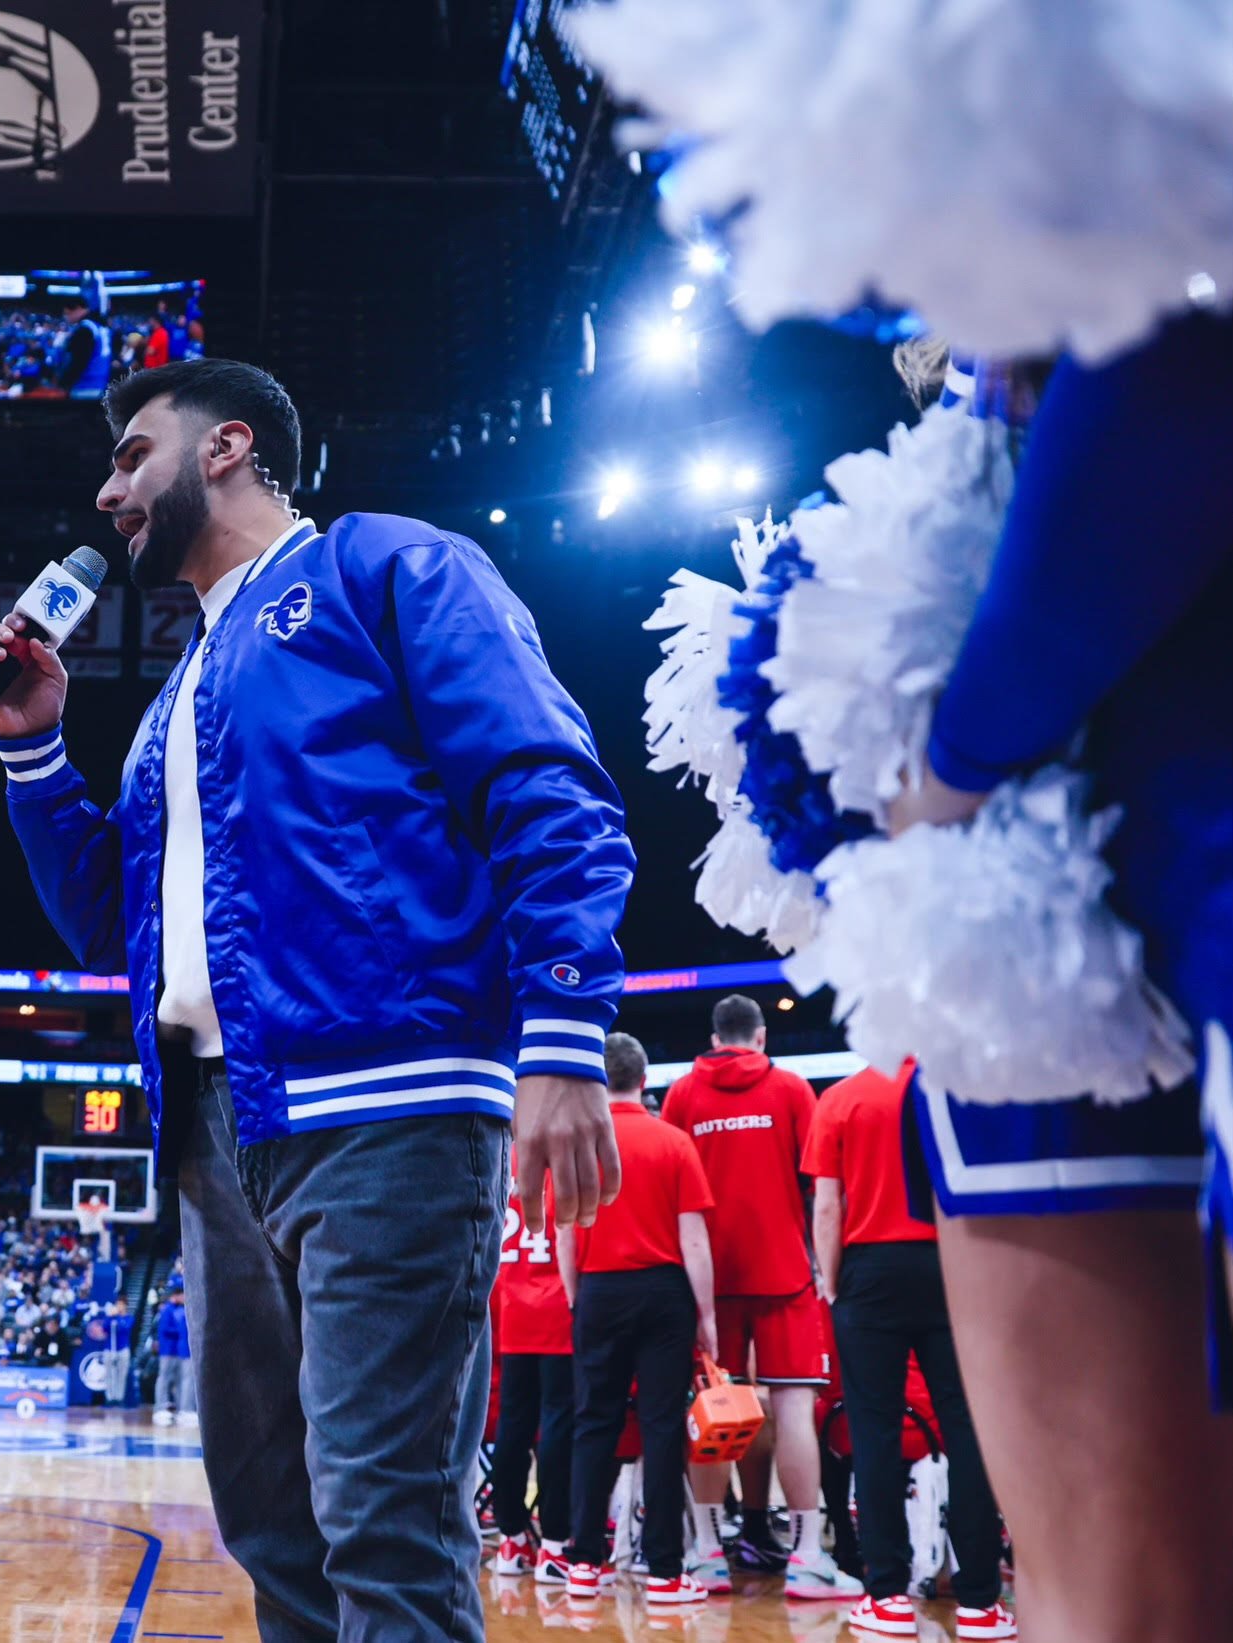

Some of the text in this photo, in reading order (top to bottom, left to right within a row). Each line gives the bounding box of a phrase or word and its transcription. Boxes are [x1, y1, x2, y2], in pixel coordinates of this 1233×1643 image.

[188, 31, 240, 150] Center
[84, 1104, 116, 1132] 30
[693, 1115, 772, 1136] RUTGERS
[500, 1206, 551, 1263] 24
